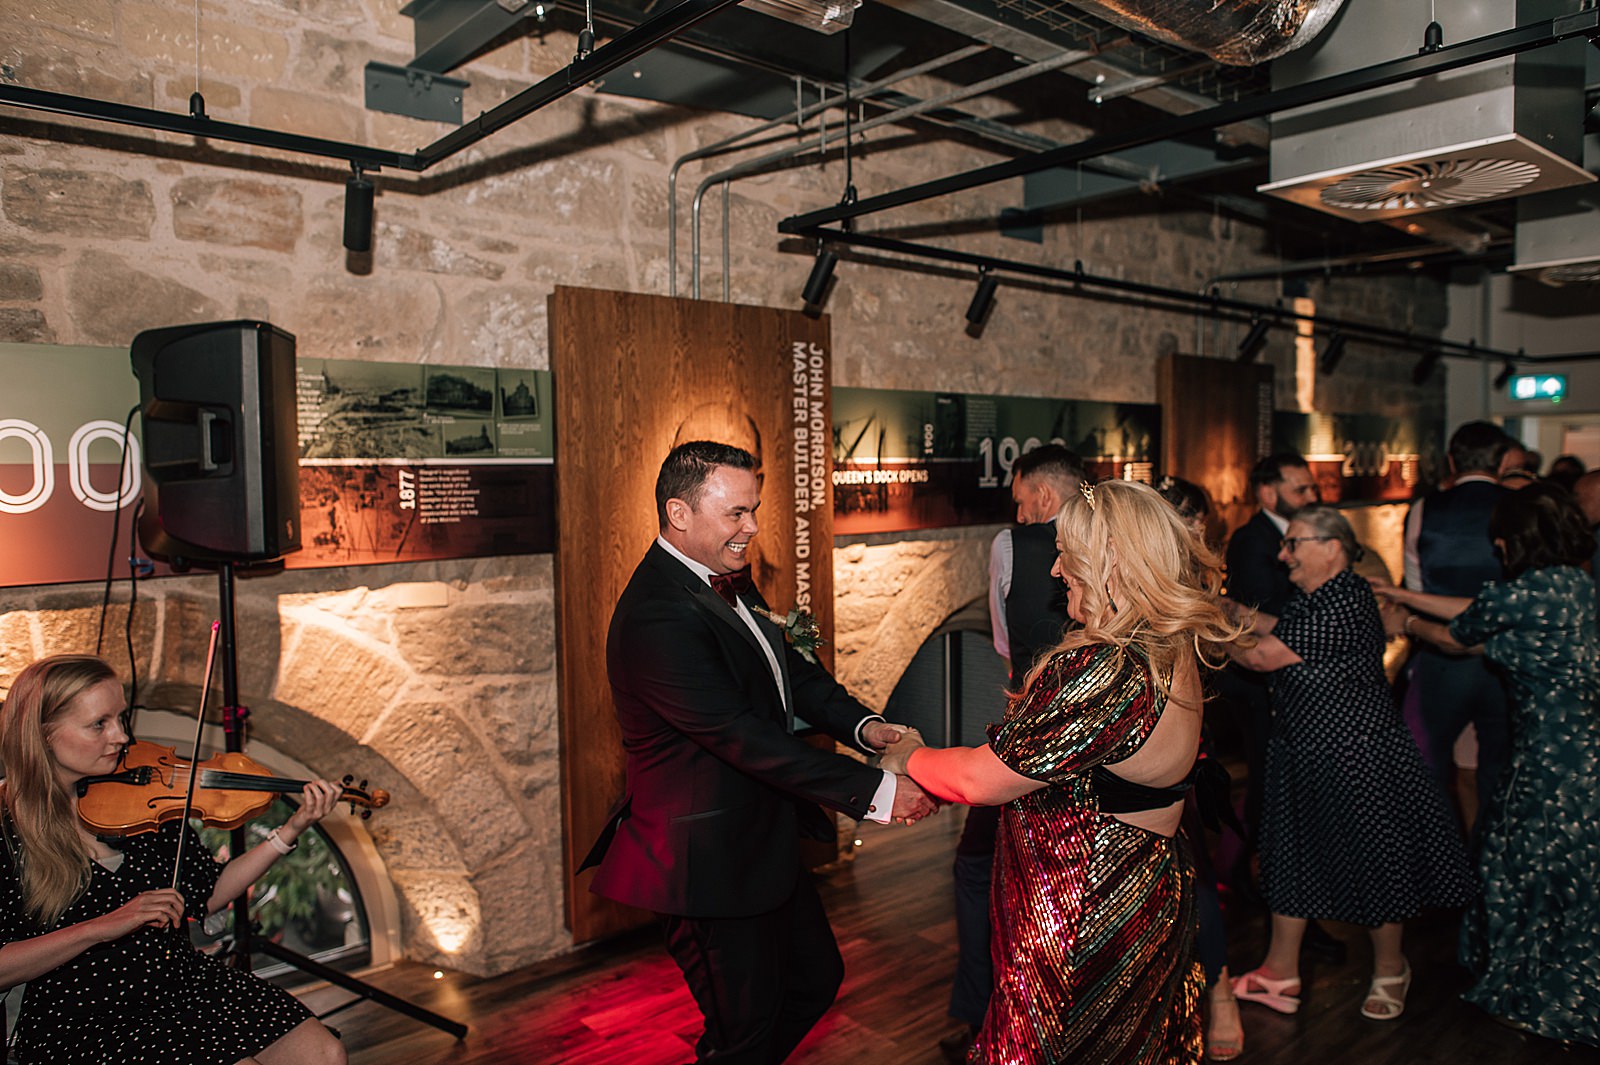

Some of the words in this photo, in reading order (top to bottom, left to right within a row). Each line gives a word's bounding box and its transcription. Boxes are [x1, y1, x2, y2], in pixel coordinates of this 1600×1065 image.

[793, 342, 808, 422] MASTER
[809, 342, 824, 396] JOHN
[794, 427, 810, 513] BUILDER
[810, 401, 825, 510] MORRISON,
[832, 470, 873, 486] QUEEN'S
[873, 470, 898, 483] DOCK
[899, 469, 929, 482] OPENS
[399, 470, 415, 509] 1877
[795, 517, 810, 558] AND
